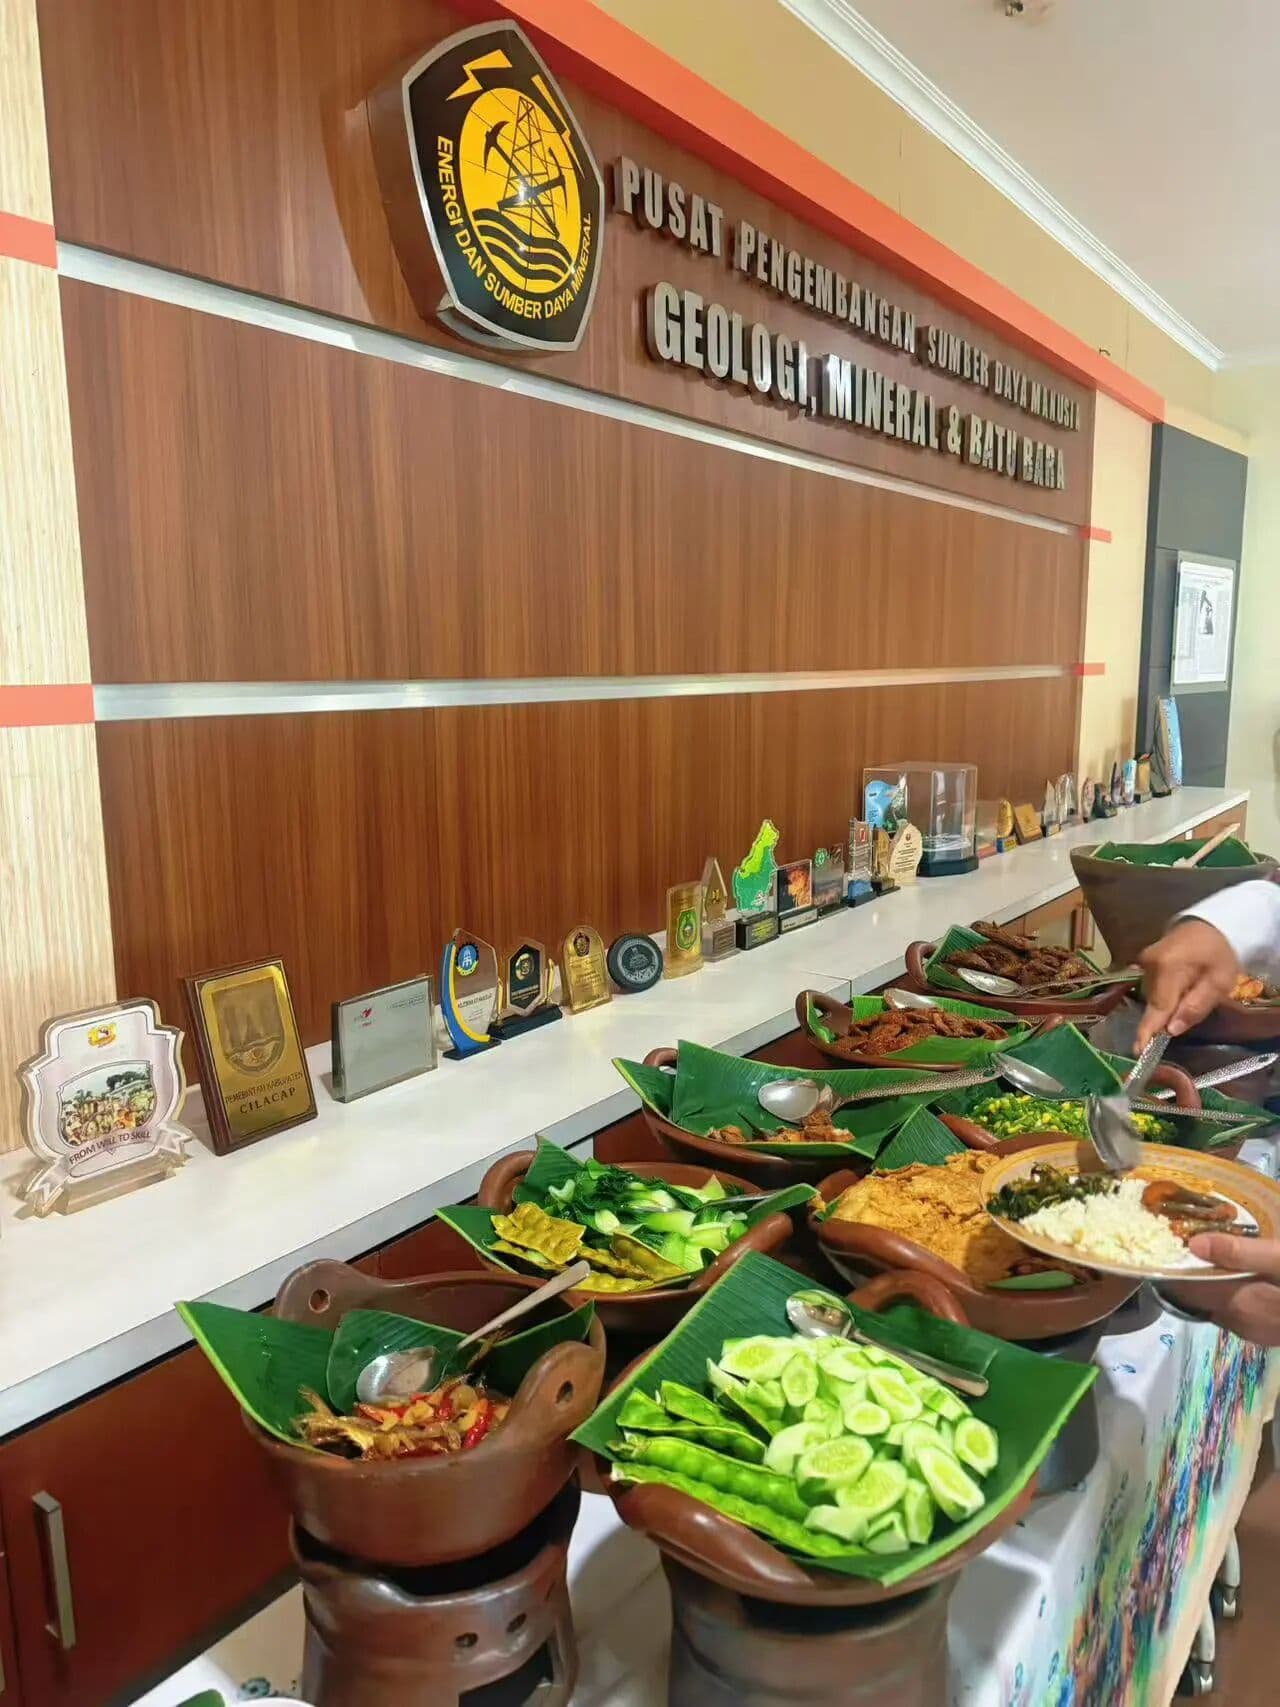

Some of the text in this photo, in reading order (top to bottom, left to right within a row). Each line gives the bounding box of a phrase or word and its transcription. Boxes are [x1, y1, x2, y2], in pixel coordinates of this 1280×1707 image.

[436, 135, 592, 319] ENERGI DAN SUMBER DAYA MINERAL
[617, 155, 1081, 432] PUSAT PENGEMBANGAN SUMBER DAYA MANUSIA
[826, 352, 939, 450] MINERAL
[946, 404, 962, 456] &
[968, 413, 1018, 477] BATU
[1022, 435, 1066, 490] BARA
[68, 1143, 97, 1165] FROM
[118, 1132, 130, 1142] TO
[130, 1129, 151, 1141] SKILL
[239, 1086, 297, 1114] CILACAP
